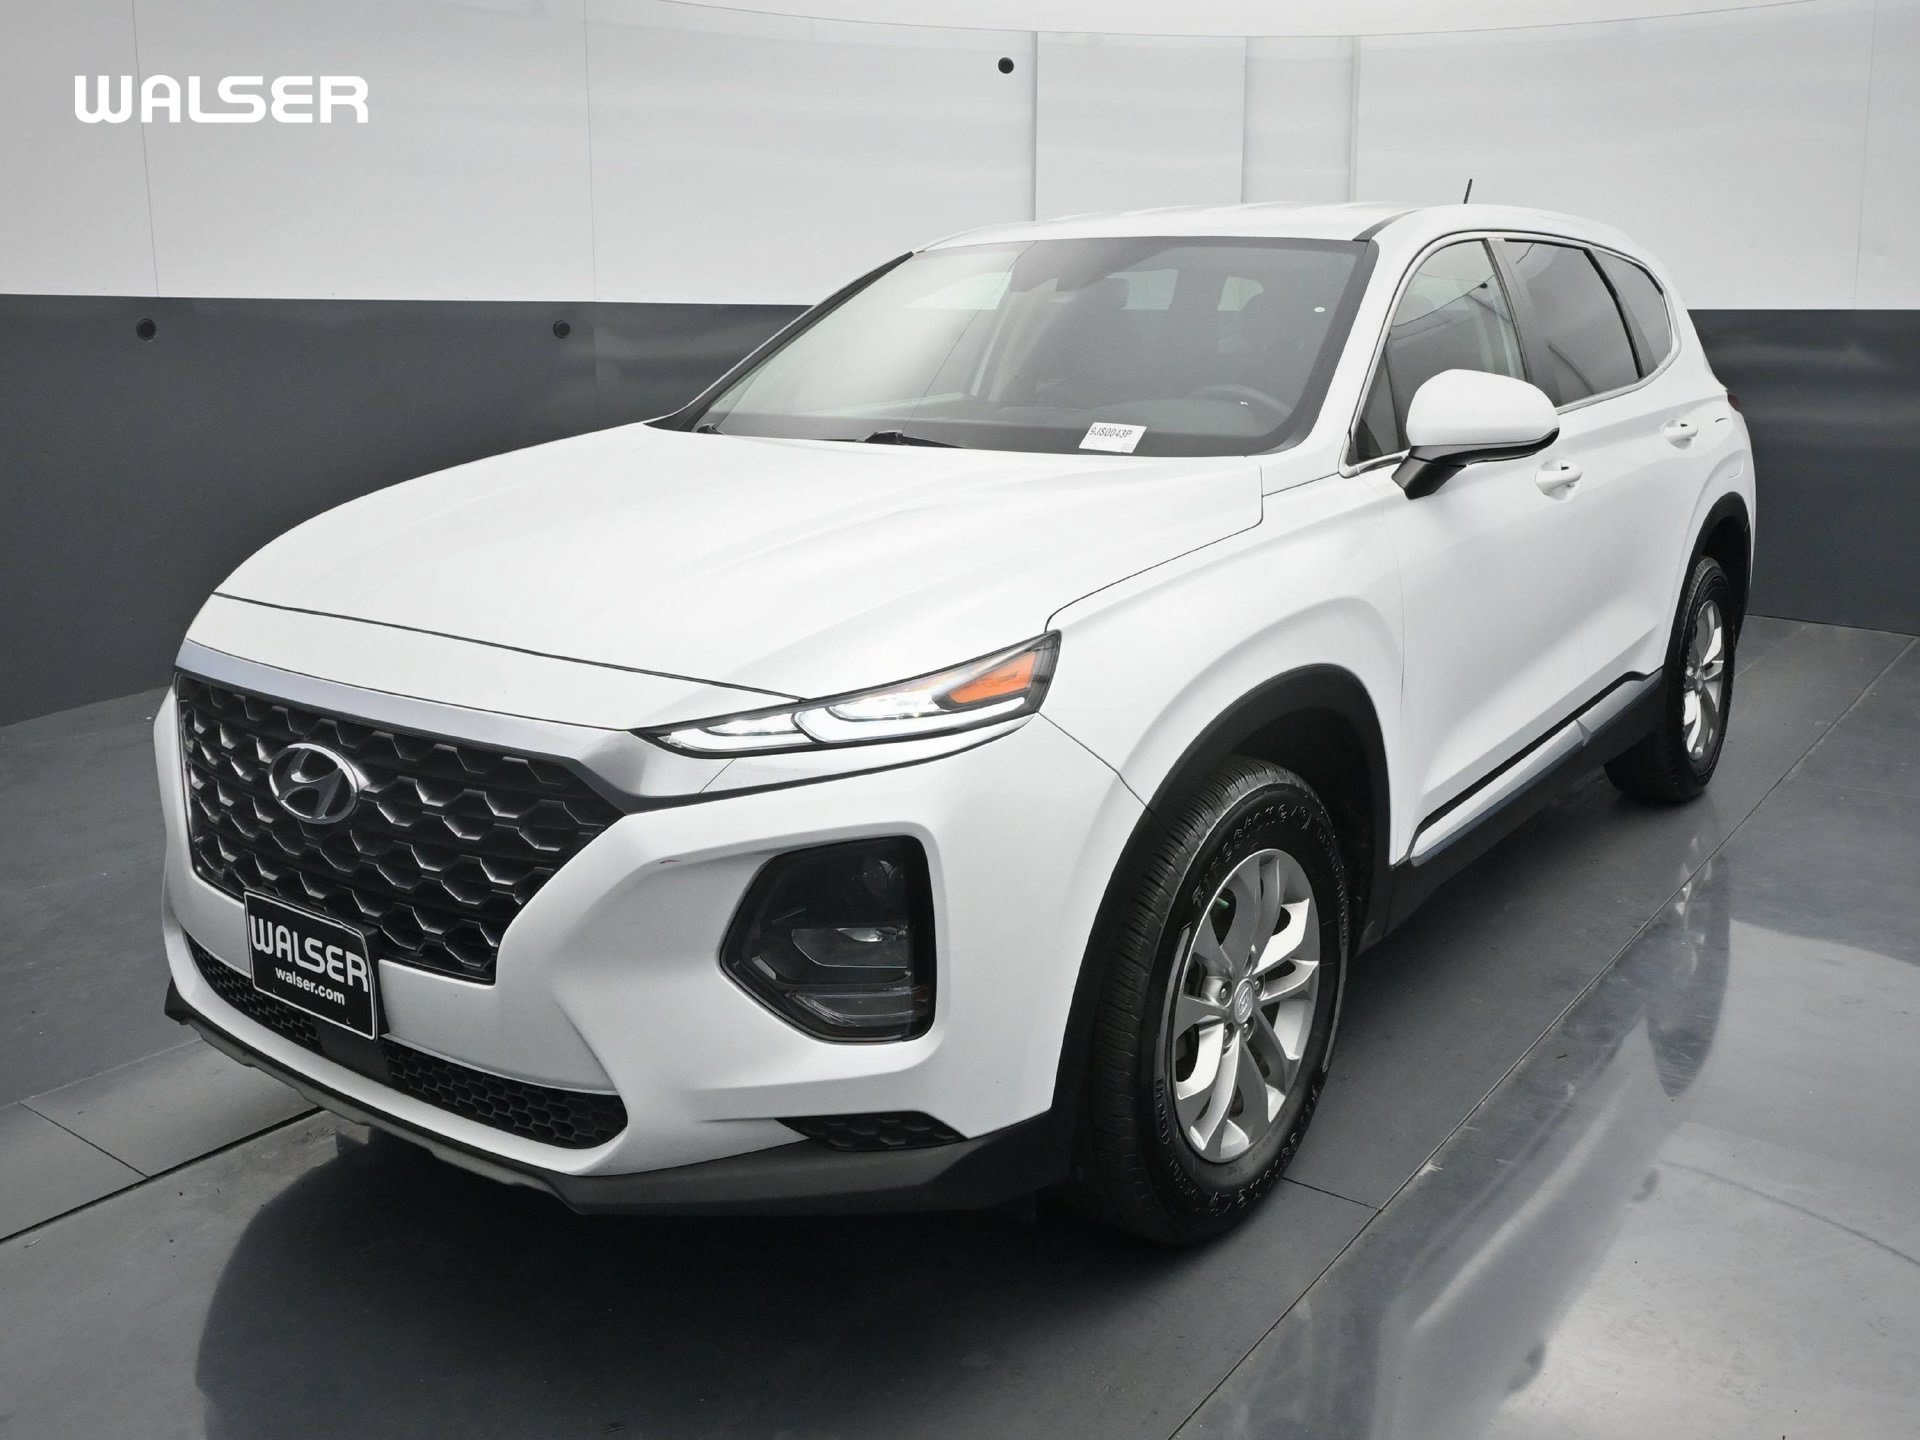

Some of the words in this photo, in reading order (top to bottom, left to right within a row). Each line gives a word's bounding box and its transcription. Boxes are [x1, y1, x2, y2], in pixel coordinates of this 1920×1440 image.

[1089, 426, 1133, 439] 9JS0043P
[250, 915, 369, 993] WALSER
[275, 967, 346, 1006] walser.com
